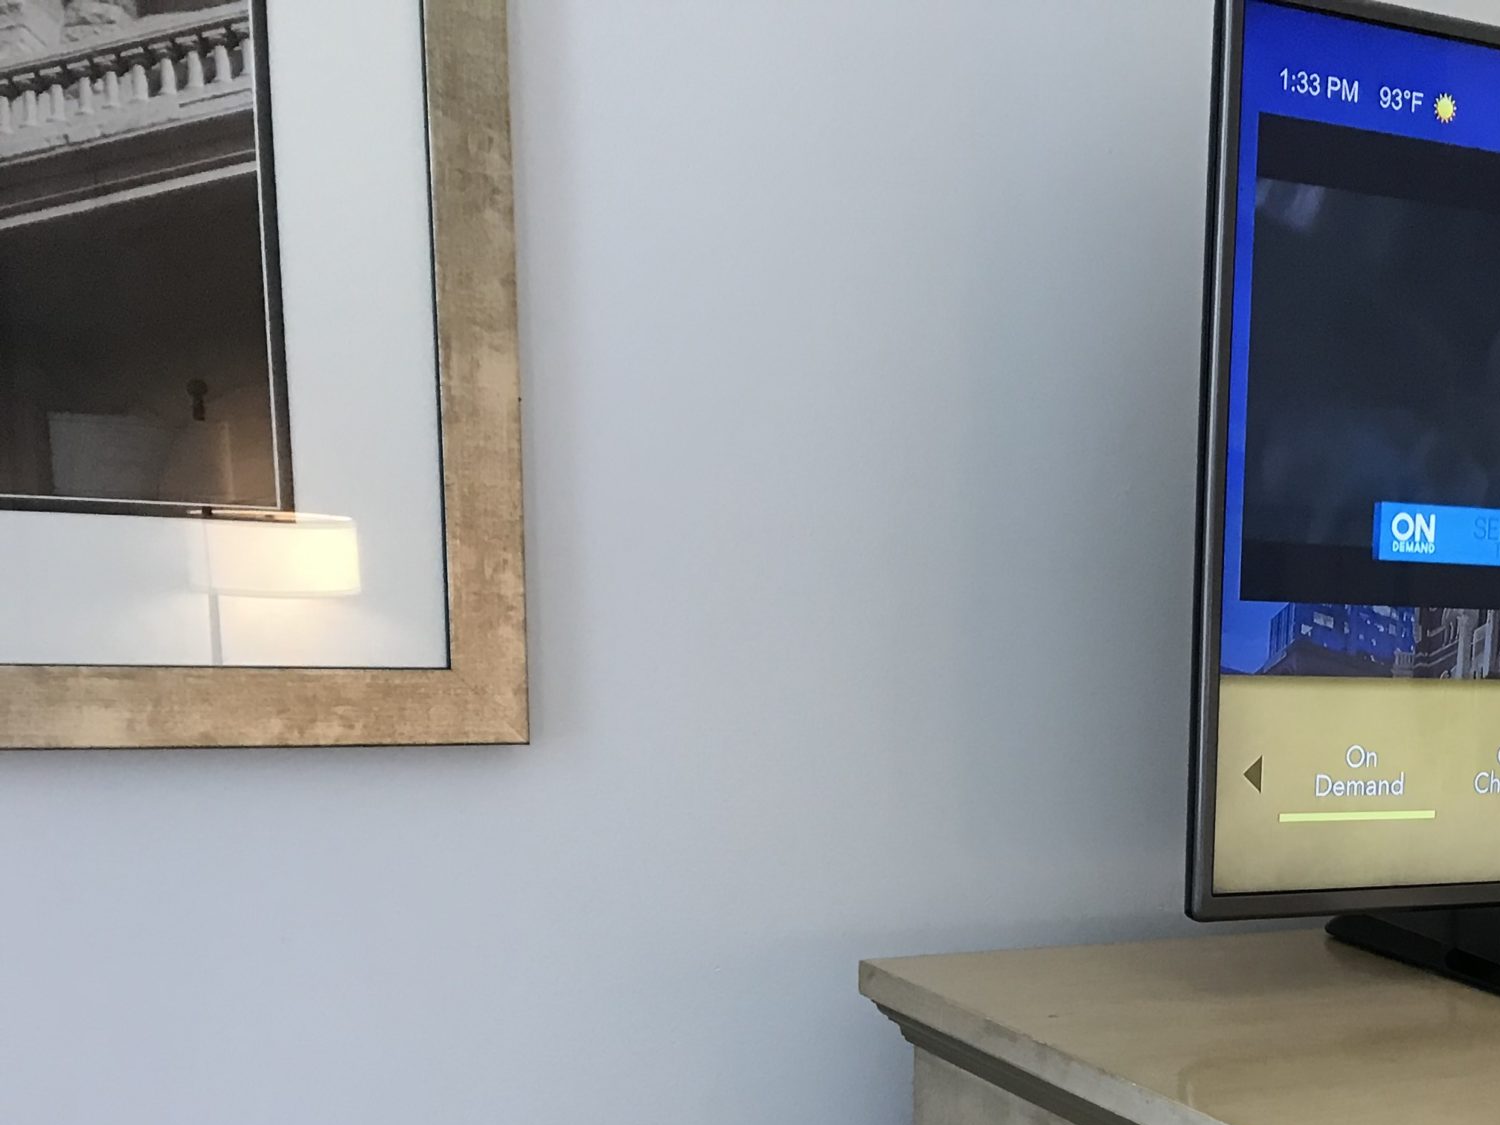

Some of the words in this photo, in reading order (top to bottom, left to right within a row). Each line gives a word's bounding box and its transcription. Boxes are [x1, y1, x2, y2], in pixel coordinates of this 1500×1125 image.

[1280, 67, 1321, 96] 1:33
[1327, 76, 1359, 103] PM
[1379, 86, 1424, 113] 93°F
[1391, 512, 1437, 543] ON
[1392, 541, 1436, 555] DEMAND
[1346, 744, 1378, 768] On
[1314, 771, 1405, 797] Demand
